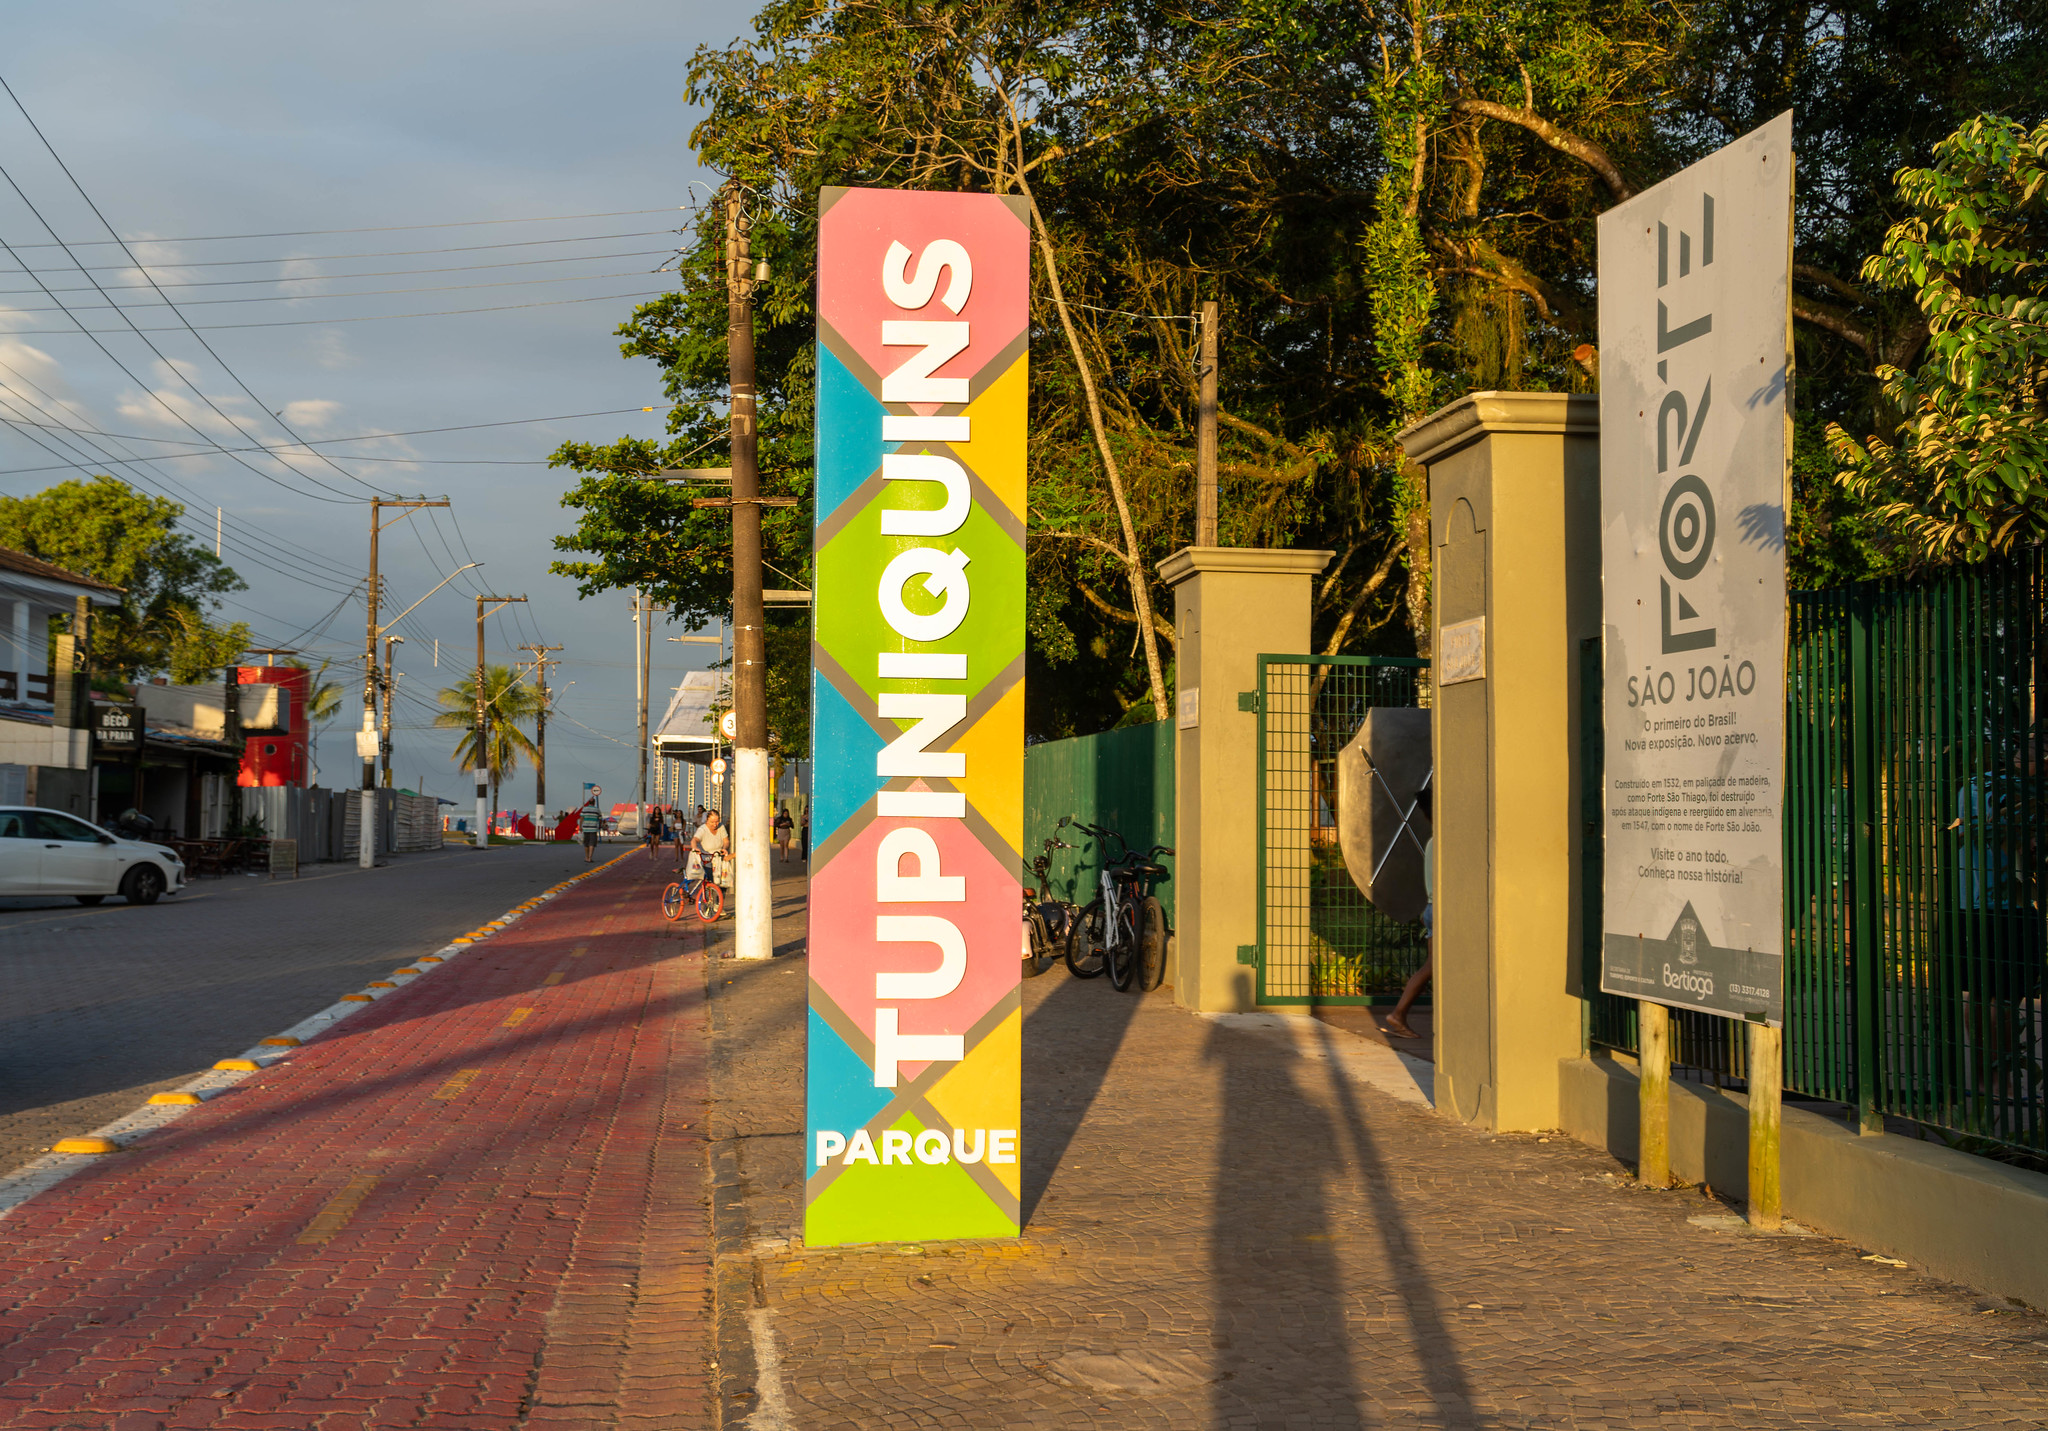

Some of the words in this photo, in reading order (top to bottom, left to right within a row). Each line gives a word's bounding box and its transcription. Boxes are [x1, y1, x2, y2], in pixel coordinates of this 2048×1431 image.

[1657, 192, 1716, 654] FORTE
[873, 238, 973, 1088] TUPINIQUINS
[1627, 665, 1676, 708] SÃO
[1686, 654, 1757, 702] JOÃO
[102, 714, 129, 727] BECO
[1644, 719, 1652, 732] O
[1654, 716, 1692, 734] primeiro
[1694, 714, 1706, 729] do
[1708, 711, 1737, 727] Brasil!
[96, 730, 108, 740] DA
[109, 731, 134, 741] PRAIA
[1625, 738, 1646, 751] Nova
[1648, 734, 1696, 751] exposição.
[1698, 734, 1722, 747] Novo
[1724, 732, 1759, 745] acervo.
[1652, 780, 1663, 789] em
[1664, 778, 1681, 790] 1532,
[1683, 779, 1694, 788] em
[1696, 776, 1726, 790] paliçada
[1728, 776, 1737, 787] de
[1739, 774, 1770, 787] madeira,
[1627, 794, 1646, 803] como
[1647, 792, 1665, 803] Forte
[1667, 791, 1680, 802] São
[1682, 791, 1708, 804] Thiago,
[1709, 791, 1719, 802] foi
[1611, 806, 1627, 818] após
[1628, 807, 1651, 818] ataque
[1652, 806, 1681, 818] indígena
[1683, 808, 1688, 817] e
[1690, 806, 1724, 819] reerguido
[1726, 808, 1737, 817] em
[1621, 822, 1632, 831] em
[1633, 820, 1650, 832] 1547,
[1651, 822, 1666, 831] com
[1667, 823, 1672, 831] o
[1673, 823, 1693, 831] nome
[1694, 821, 1704, 832] de
[1705, 821, 1725, 832] Forte
[1726, 821, 1740, 832] São
[1741, 821, 1763, 833] João.
[1650, 847, 1675, 861] Visite
[1677, 851, 1684, 861] o
[1686, 851, 1703, 862] ano
[1705, 849, 1729, 863] todo.
[1638, 865, 1675, 881] Conheça
[1677, 869, 1703, 881] nossa
[1705, 868, 1743, 884] história!
[1663, 962, 1714, 1001] Bertioga
[1729, 983, 1741, 994] (13)
[816, 1128, 1017, 1166] PARQUE
